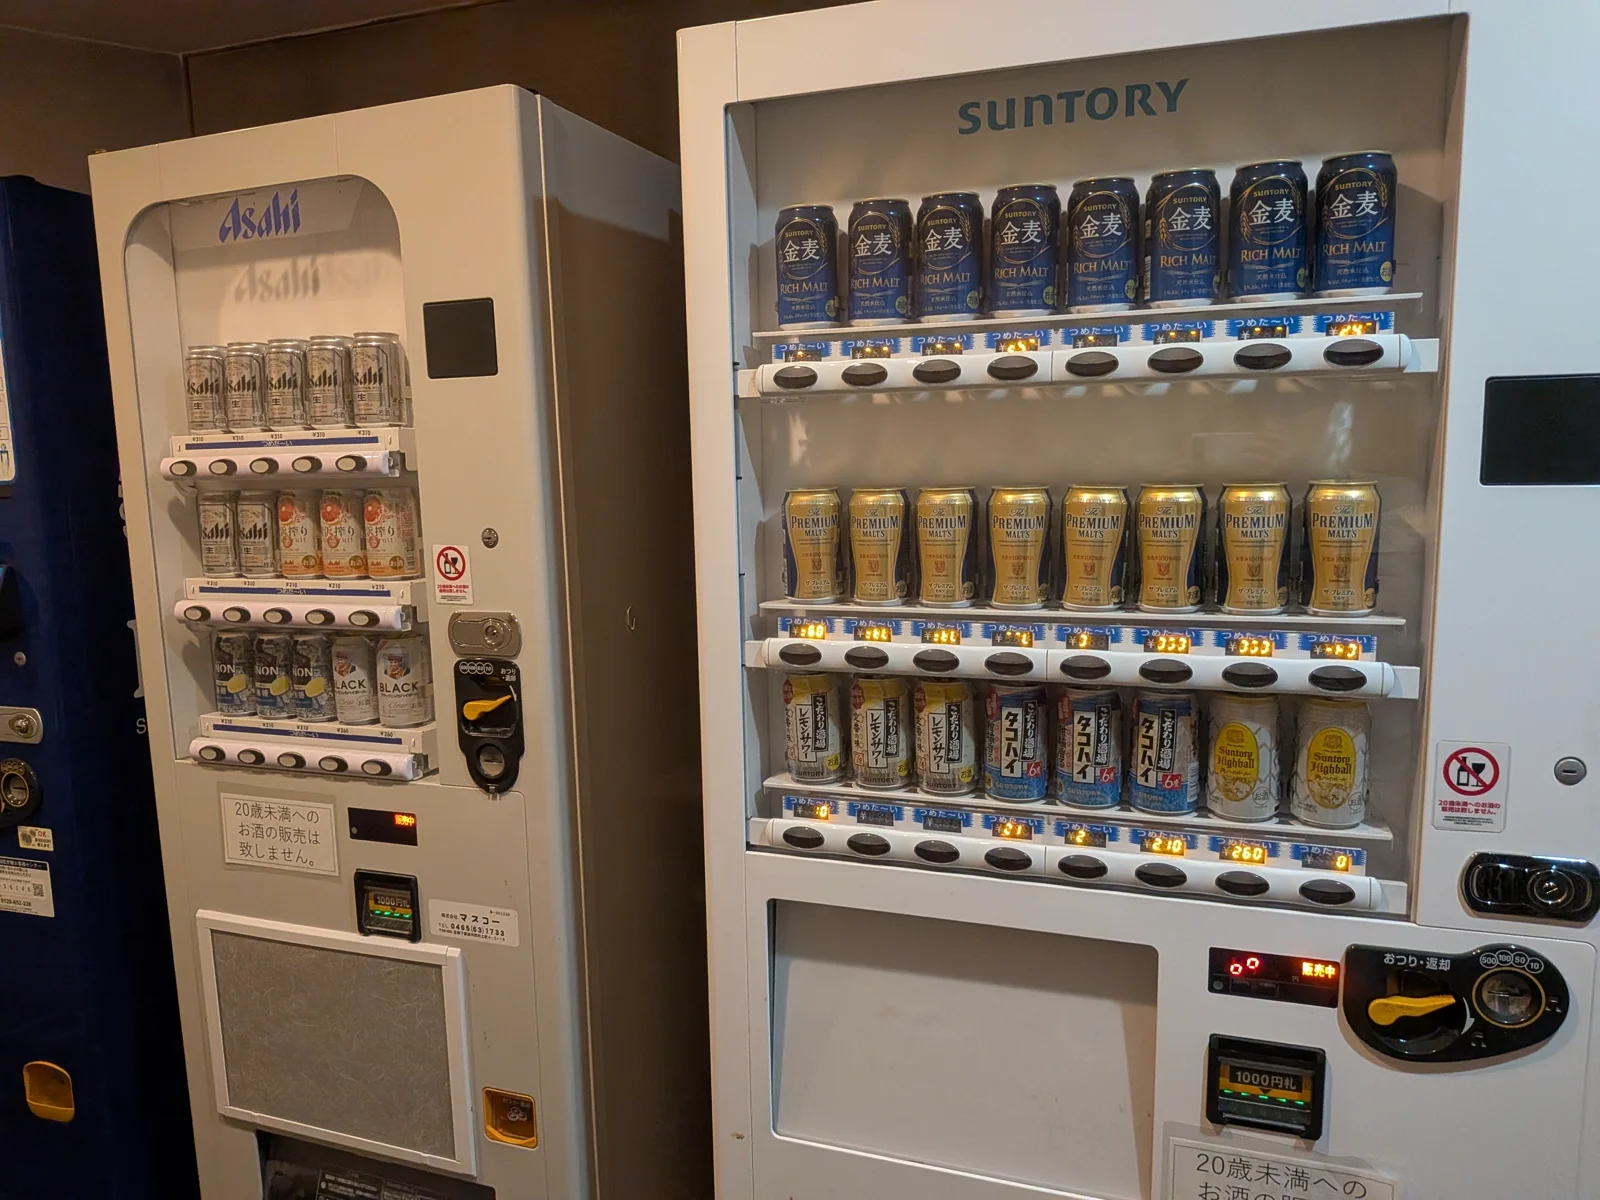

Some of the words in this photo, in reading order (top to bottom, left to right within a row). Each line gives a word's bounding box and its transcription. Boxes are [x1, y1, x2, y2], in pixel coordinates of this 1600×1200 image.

[958, 78, 1190, 135] SUNTORY
[1253, 188, 1289, 197] SUNTORY
[1335, 181, 1373, 191] SUNTORY
[1248, 198, 1295, 226] 金麦
[1329, 191, 1379, 219] 金麦
[219, 188, 301, 243] Asahi
[928, 218, 957, 226] SUNTORY
[1004, 211, 1036, 219] SUNTORY
[1168, 206, 1212, 232] 金麦
[785, 230, 813, 238] SUNTORY
[1001, 220, 1041, 246] 金麦
[1079, 213, 1122, 239] 金麦
[854, 232, 892, 257] 金麦
[924, 226, 962, 252] 金麦
[783, 238, 820, 263] 金麦
[1241, 250, 1268, 262] RICH
[1272, 248, 1301, 259] MALT
[1321, 243, 1349, 257] RICH
[1353, 241, 1386, 253] MALT
[1073, 261, 1097, 274] RICH
[1102, 260, 1129, 271] MALT
[1160, 255, 1187, 267] RICH
[1192, 255, 1216, 265] MALT
[920, 274, 944, 286] RICH
[947, 272, 971, 283] MALT
[995, 268, 1018, 280] RICH
[1020, 267, 1048, 278] MALT
[780, 283, 799, 294] RICH
[801, 282, 828, 292] MALT
[850, 278, 869, 289] RICH
[872, 278, 899, 288] MALT
[791, 514, 839, 528] PREMIUM
[852, 515, 898, 529] PREMIUM
[918, 516, 966, 530] PREMIUM
[993, 515, 1044, 530] PREMIUM
[1066, 516, 1120, 530] PREMIUM
[1140, 514, 1194, 529] PREMIUM
[1225, 513, 1284, 530] PREMIUM
[1312, 512, 1373, 529] PREMIUM
[200, 522, 230, 540] sahi
[239, 522, 267, 540] sahi
[380, 681, 418, 693] BLACK
[799, 707, 811, 760] レモンサワー
[870, 712, 883, 766] レモンサワー
[932, 716, 944, 771] レモンサワー
[1004, 711, 1020, 774] タコハイ
[1076, 715, 1092, 780] タコハイ
[1140, 718, 1155, 783] タコハイ
[1218, 746, 1253, 759] Suntory
[1313, 752, 1350, 766] Suntory
[1216, 754, 1254, 769] Highball
[1310, 762, 1352, 775] Highball
[235, 802, 319, 824] 20歳未満への
[239, 822, 321, 845] お酒の販売は
[239, 841, 315, 867] 致しません。
[460, 913, 500, 925] マスコー
[1301, 961, 1336, 979] 販売中
[1383, 952, 1451, 972] おつり・返却
[1482, 955, 1495, 965] 500
[1498, 953, 1511, 963] 100
[1515, 955, 1526, 964] 50
[1529, 961, 1540, 970] 10
[1235, 1070, 1297, 1090] 1000円札
[1196, 1153, 1367, 1199] 20歳未満への
